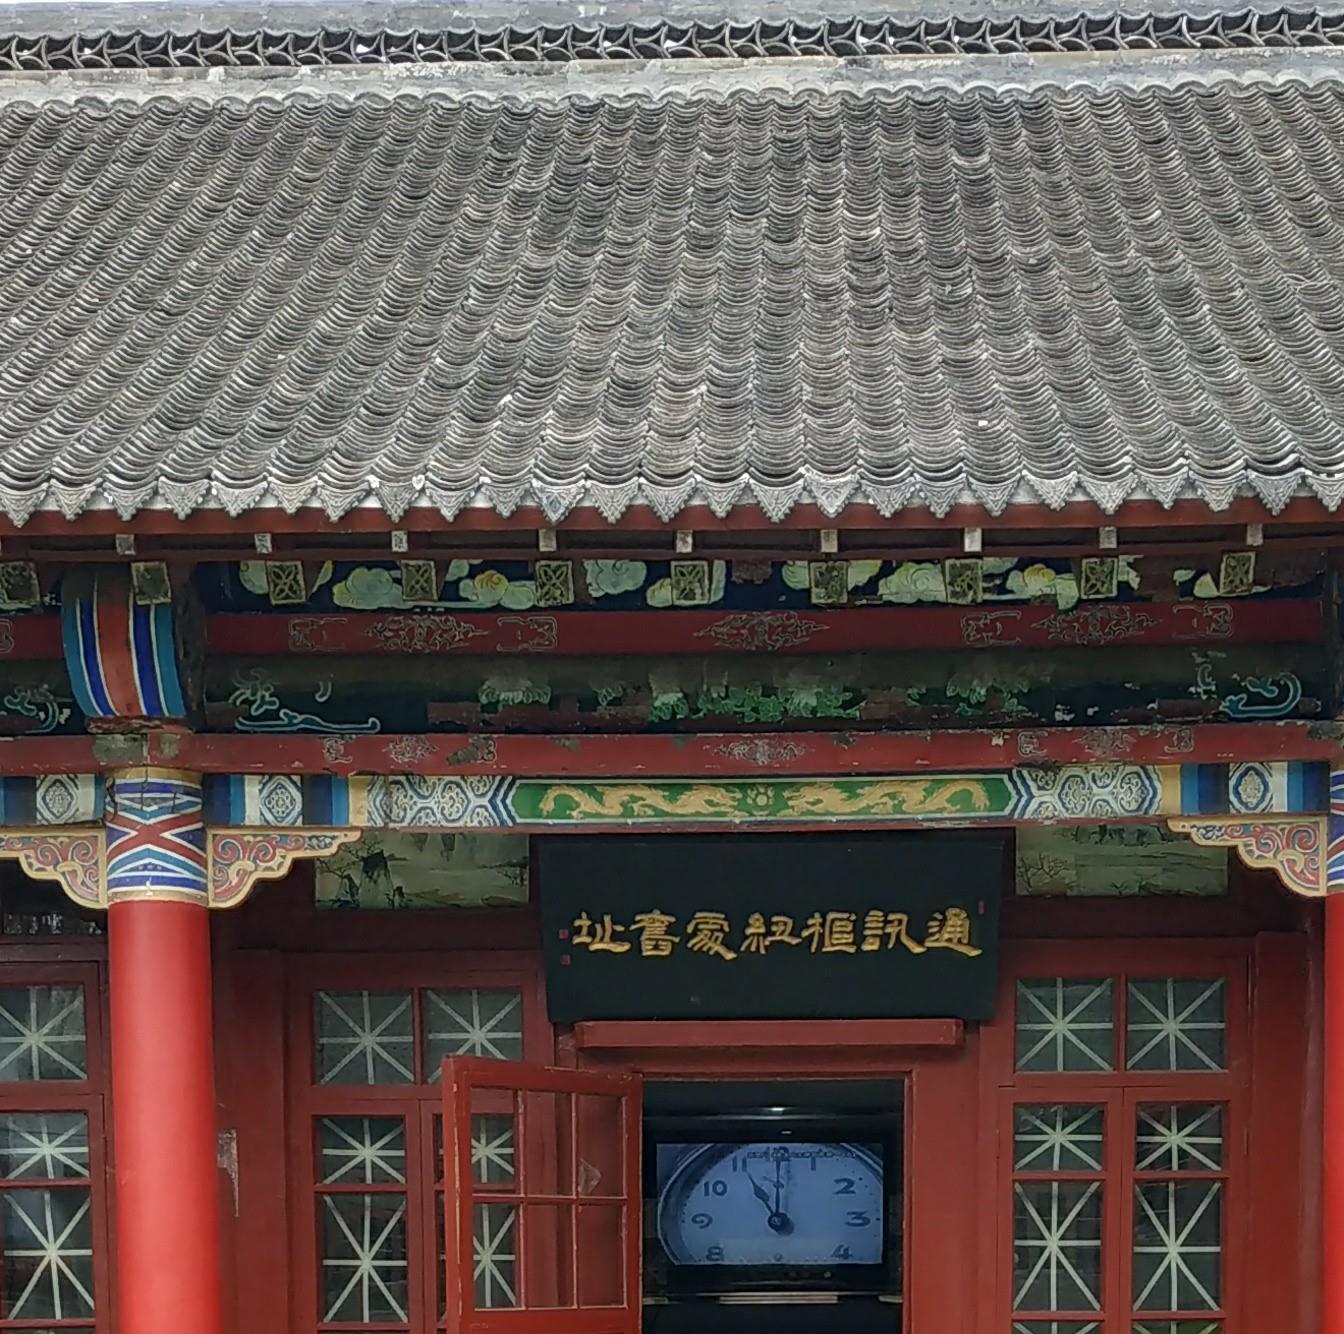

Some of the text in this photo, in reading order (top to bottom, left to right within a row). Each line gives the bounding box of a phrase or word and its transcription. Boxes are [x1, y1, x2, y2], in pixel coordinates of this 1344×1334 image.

[732, 1157, 747, 1172] 11
[703, 1180, 727, 1197] 10
[834, 1178, 856, 1195] 2
[691, 1213, 713, 1229] 9
[844, 1210, 871, 1227] 3
[706, 1246, 724, 1262] 8
[831, 1244, 853, 1260] 4
